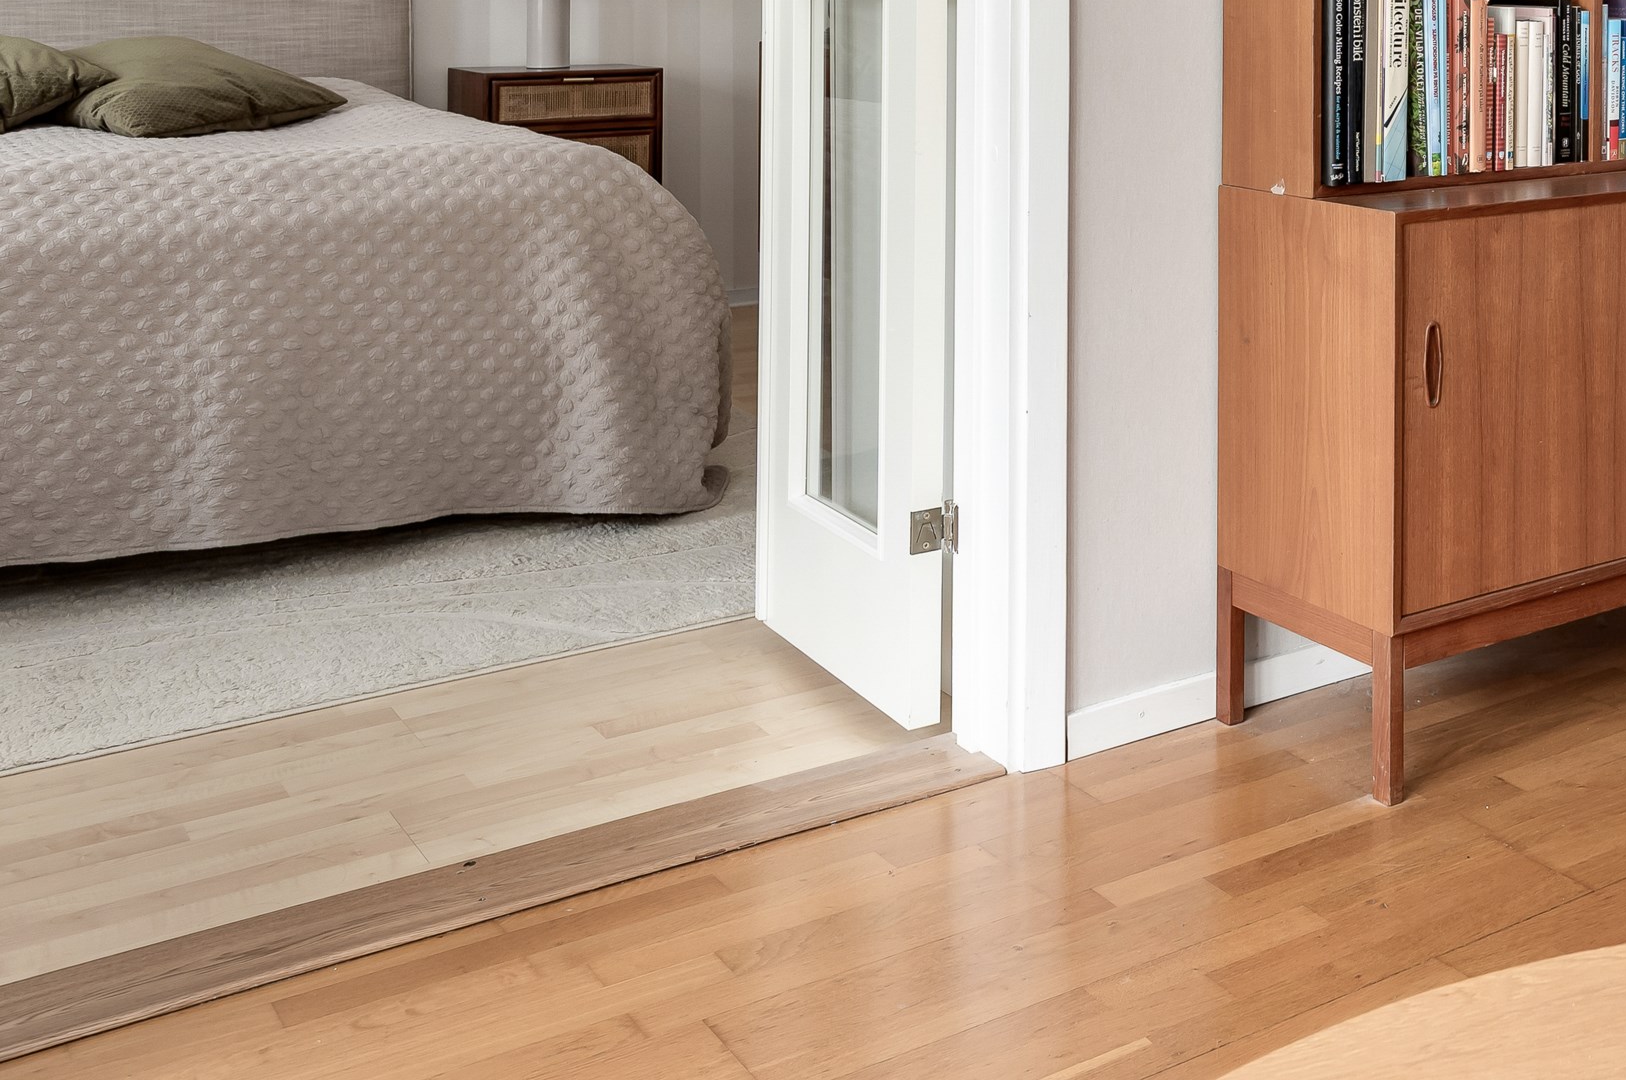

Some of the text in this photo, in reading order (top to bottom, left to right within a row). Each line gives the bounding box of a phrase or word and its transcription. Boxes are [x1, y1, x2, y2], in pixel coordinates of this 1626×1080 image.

[1335, 13, 1343, 35] Color
[1414, 8, 1422, 27] DET
[1334, 37, 1343, 65] Mixing
[1352, 40, 1363, 61] bild
[1415, 30, 1424, 59] VILDA
[1611, 33, 1619, 73] TRACKS
[1334, 66, 1343, 95] Recipes
[1562, 44, 1570, 107] Cold Mountain
